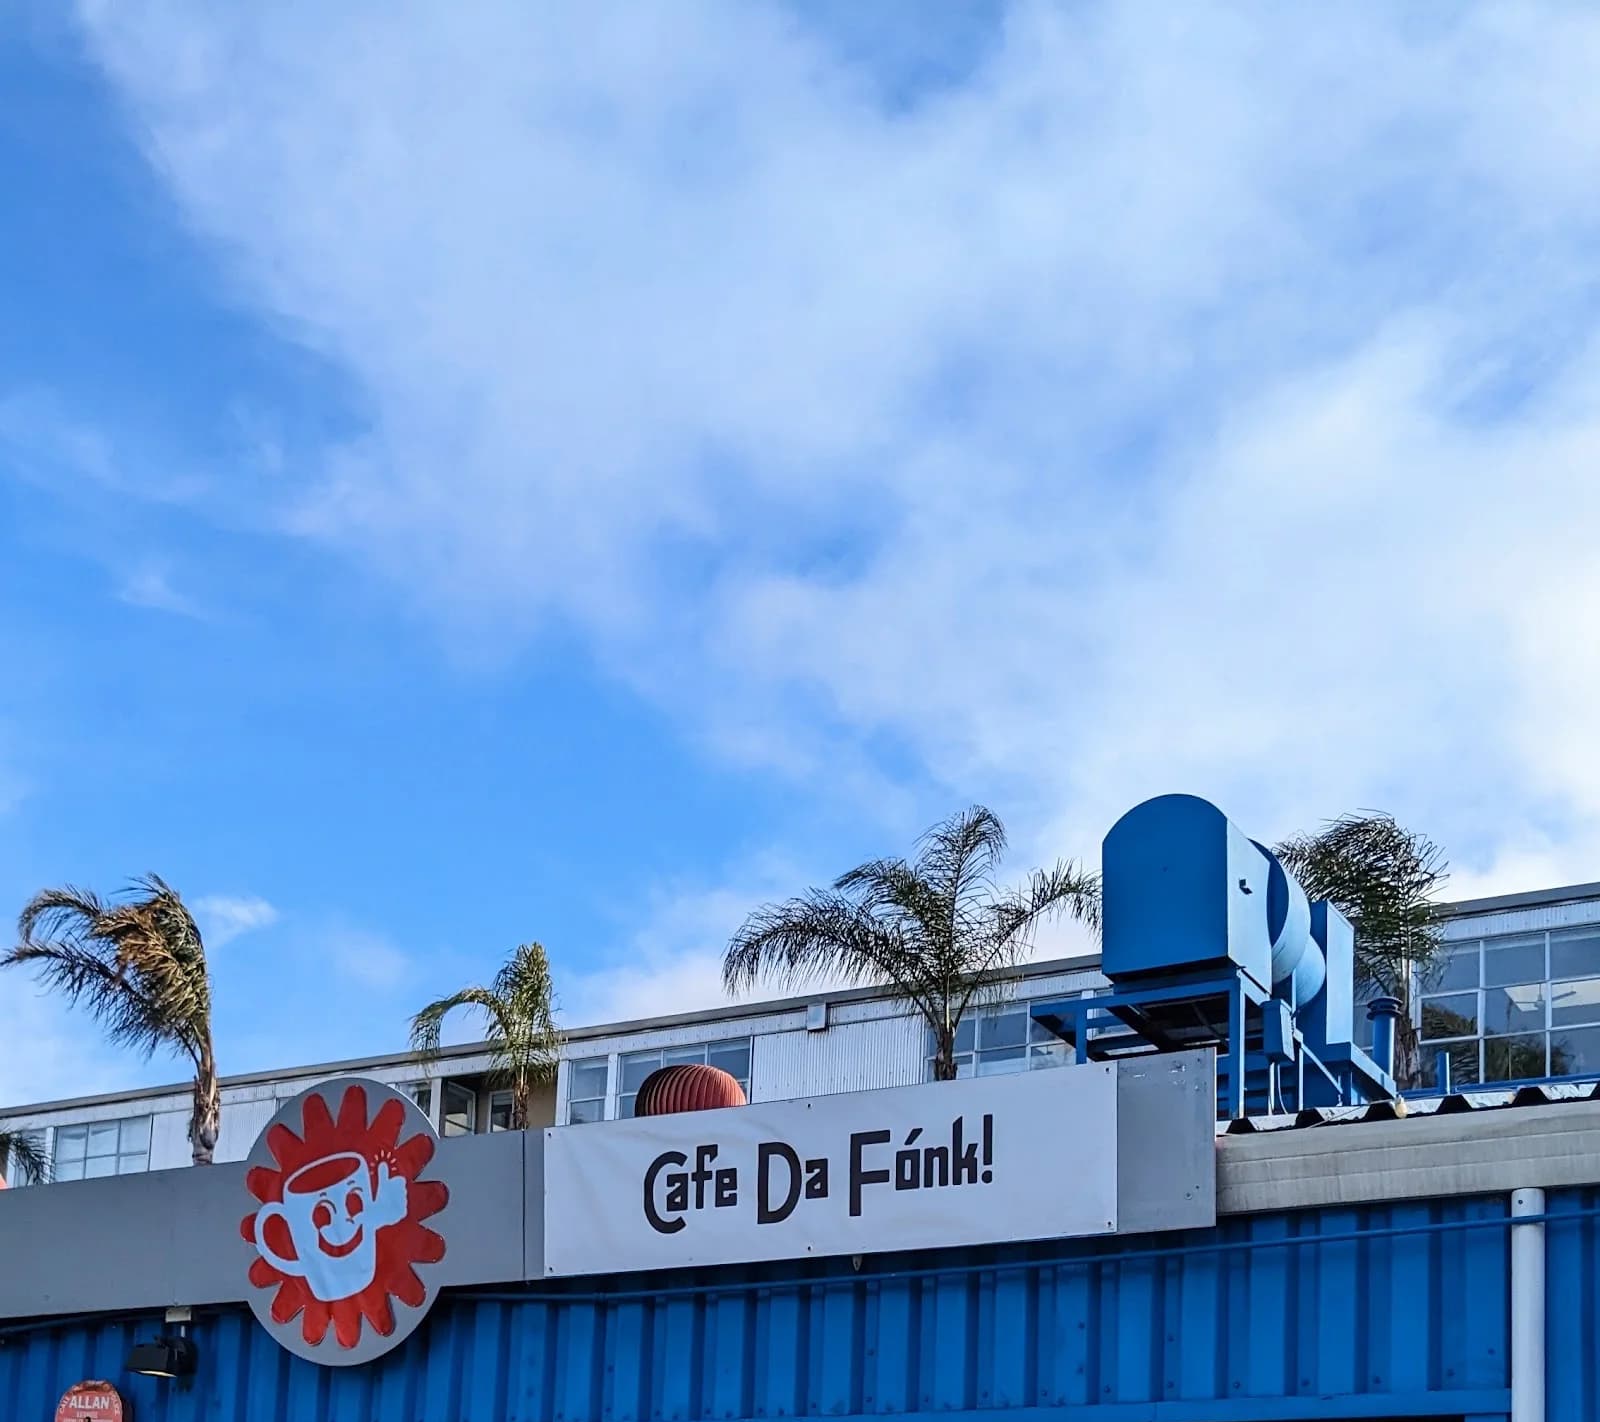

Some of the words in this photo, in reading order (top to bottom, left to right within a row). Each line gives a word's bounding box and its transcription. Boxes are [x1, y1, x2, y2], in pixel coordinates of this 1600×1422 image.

[644, 1144, 737, 1234] Cafe
[757, 1142, 828, 1225] Da
[849, 1114, 993, 1216] Fónk!
[69, 1395, 110, 1409] ALLAN
